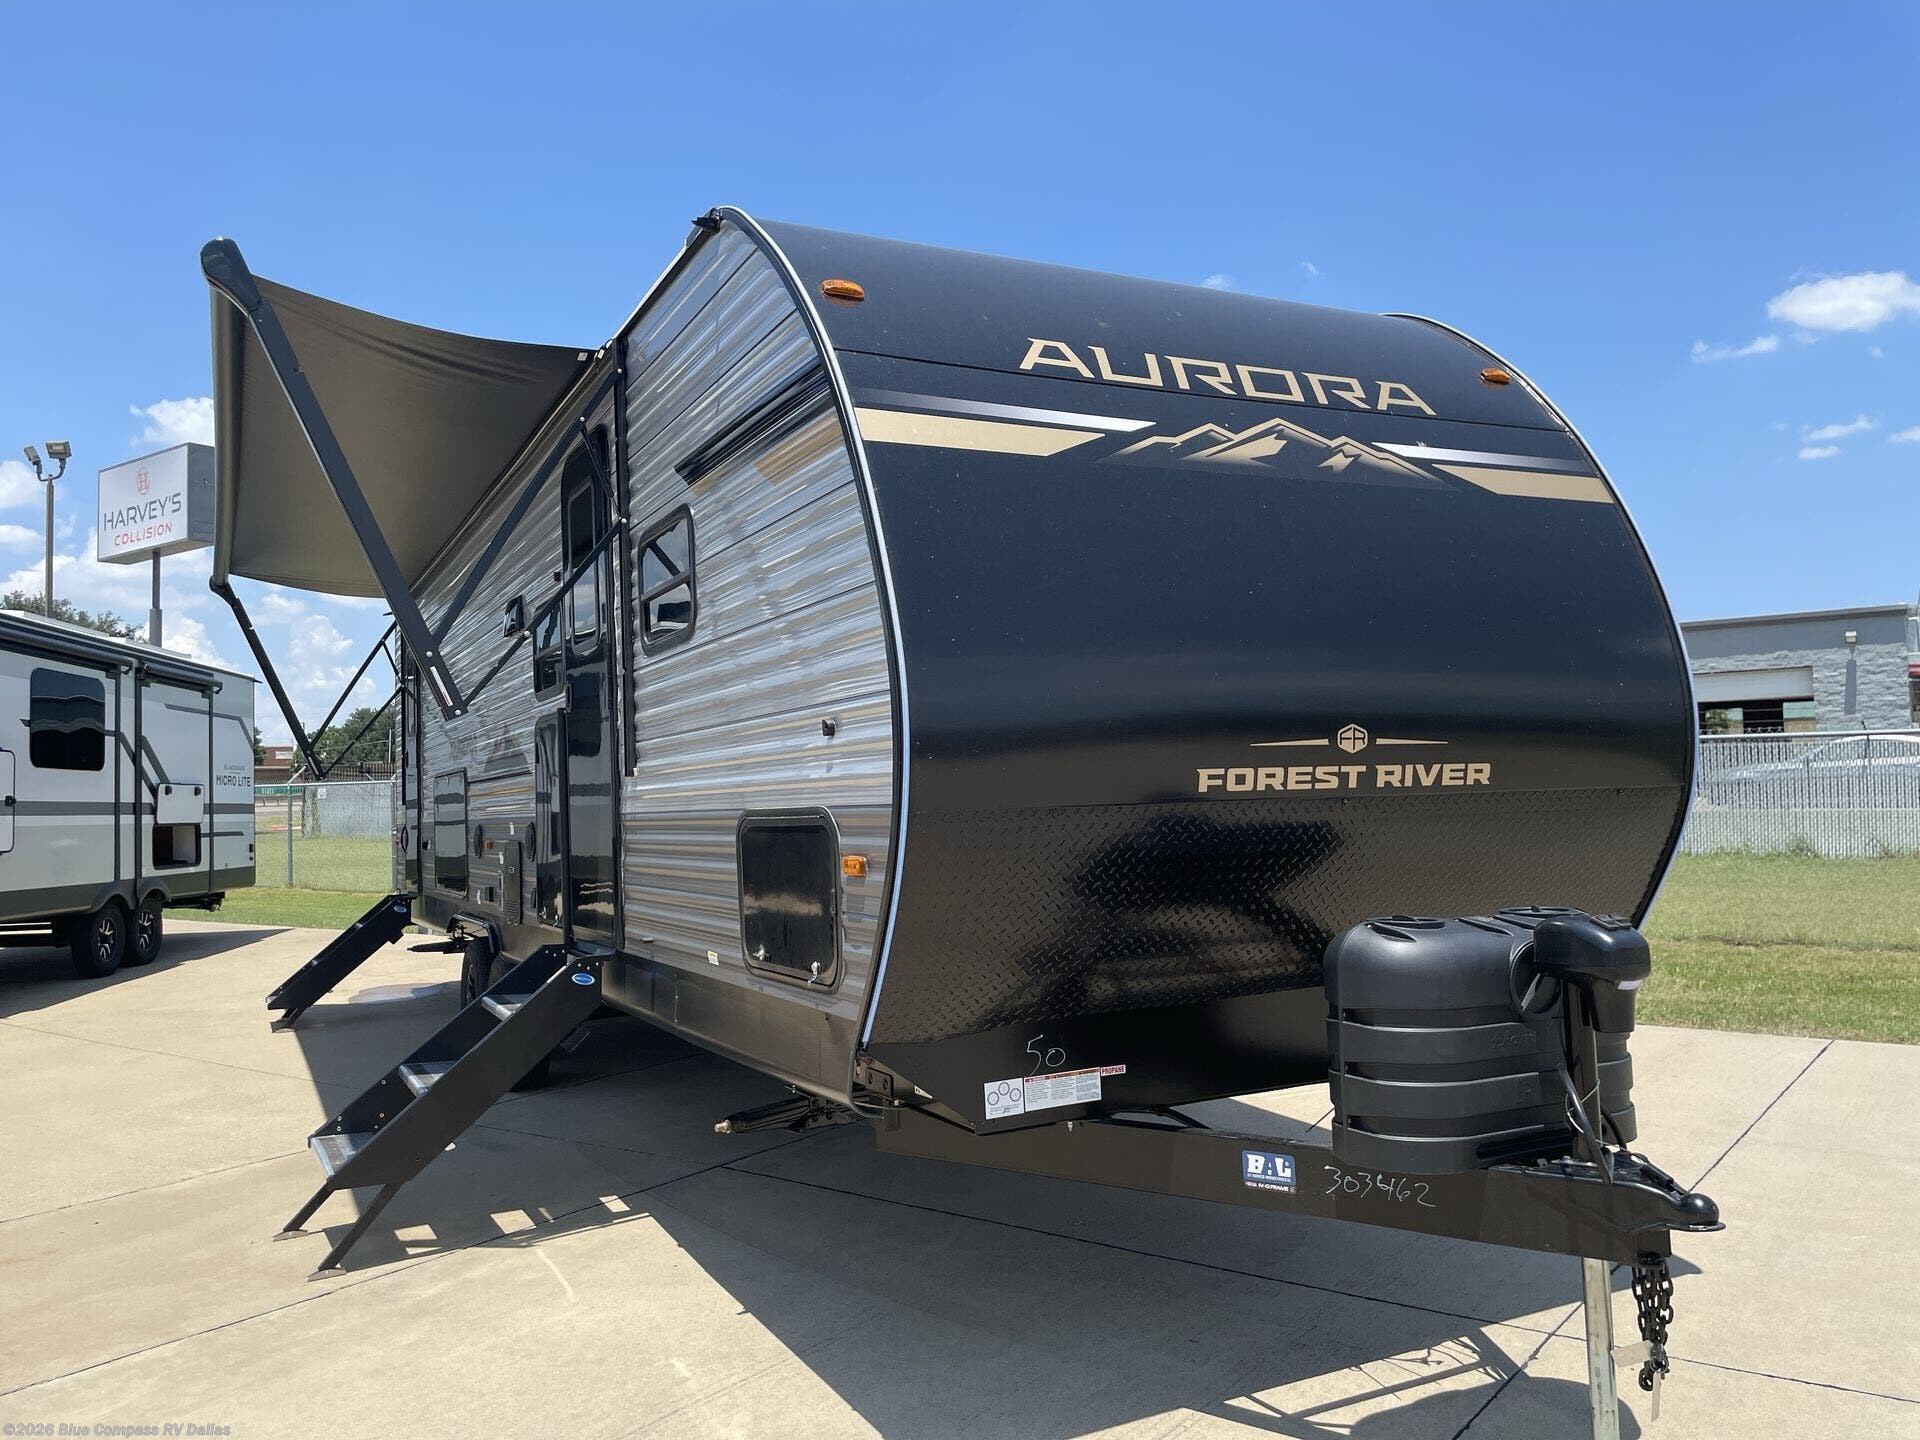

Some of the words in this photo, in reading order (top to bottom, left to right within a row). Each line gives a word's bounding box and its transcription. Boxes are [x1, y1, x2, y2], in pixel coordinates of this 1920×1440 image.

[1018, 337, 1437, 416] AURORA
[103, 492, 182, 532] HARVEY'S
[114, 521, 173, 546] COLLISION
[216, 774, 237, 787] MICRO
[238, 776, 251, 787] LITE
[1196, 764, 1367, 793] FOREST
[1375, 762, 1491, 788] RIVER
[1026, 1034, 1066, 1077] 50
[1101, 1065, 1125, 1076] PROPANE
[1247, 1154, 1292, 1177] BAL
